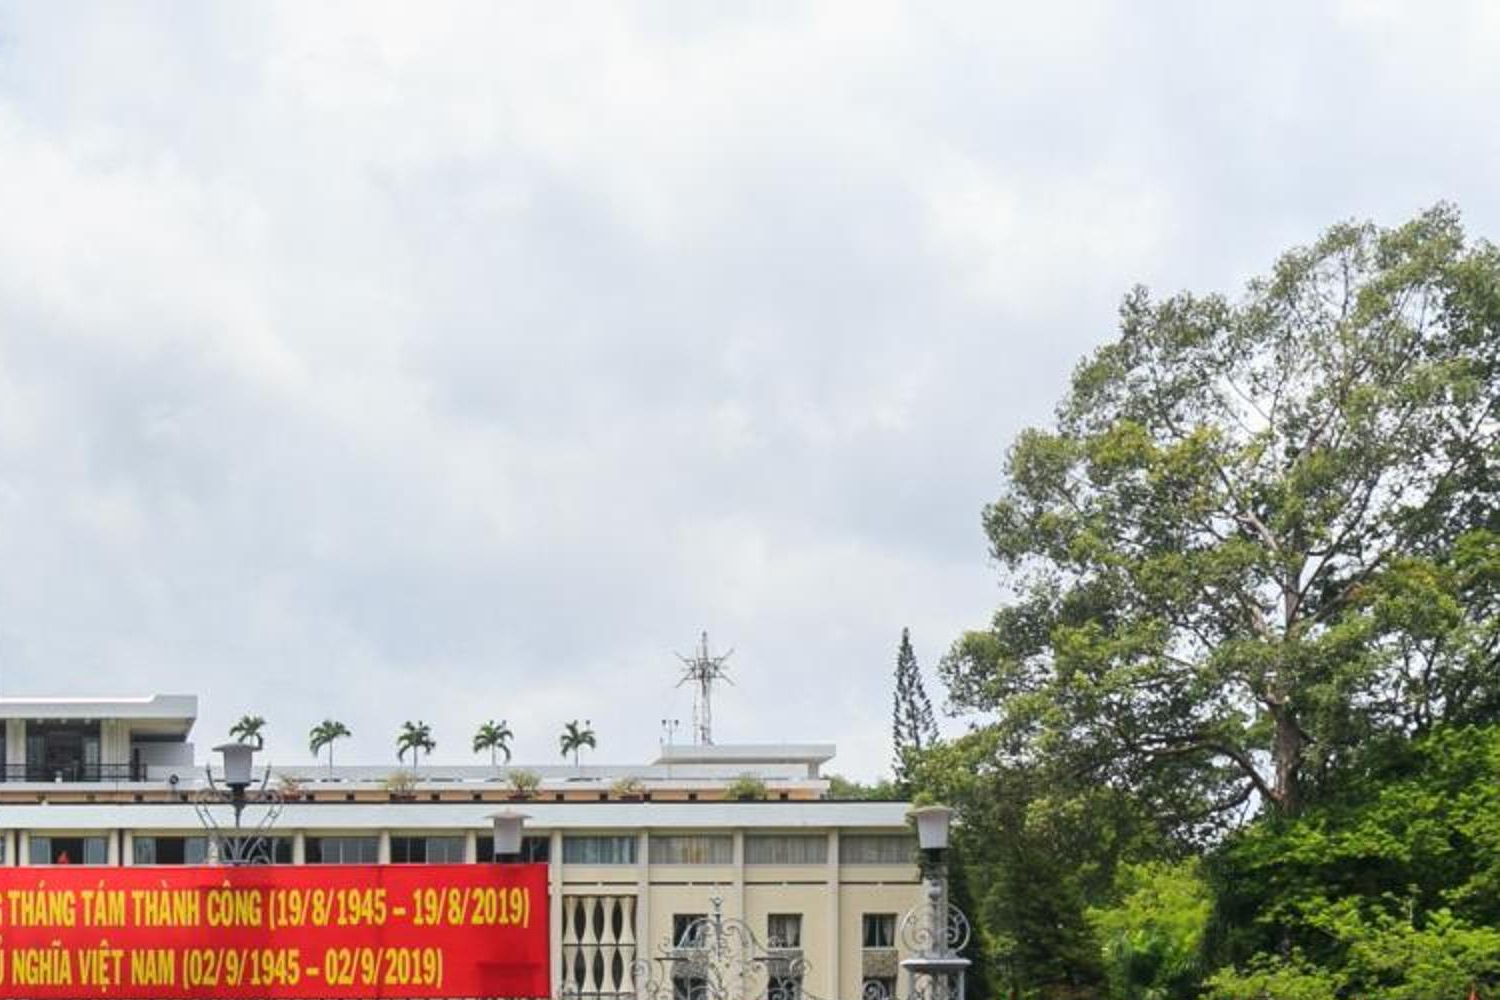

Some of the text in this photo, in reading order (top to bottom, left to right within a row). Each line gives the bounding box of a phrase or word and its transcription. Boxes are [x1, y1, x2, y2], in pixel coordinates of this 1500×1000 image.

[6, 879, 77, 929] THÁNG
[79, 879, 127, 928] TÁM
[130, 879, 201, 928] THÀNH
[206, 879, 262, 928] CÔNG
[269, 887, 388, 931] (19/8/1945
[412, 887, 530, 929] 19/8/2019)
[11, 939, 73, 986] NGHĨA
[78, 938, 125, 993] VIỆT
[130, 948, 175, 986] NAM
[182, 948, 301, 990] (02/9/1945
[324, 947, 443, 989] 02/9/2019)
